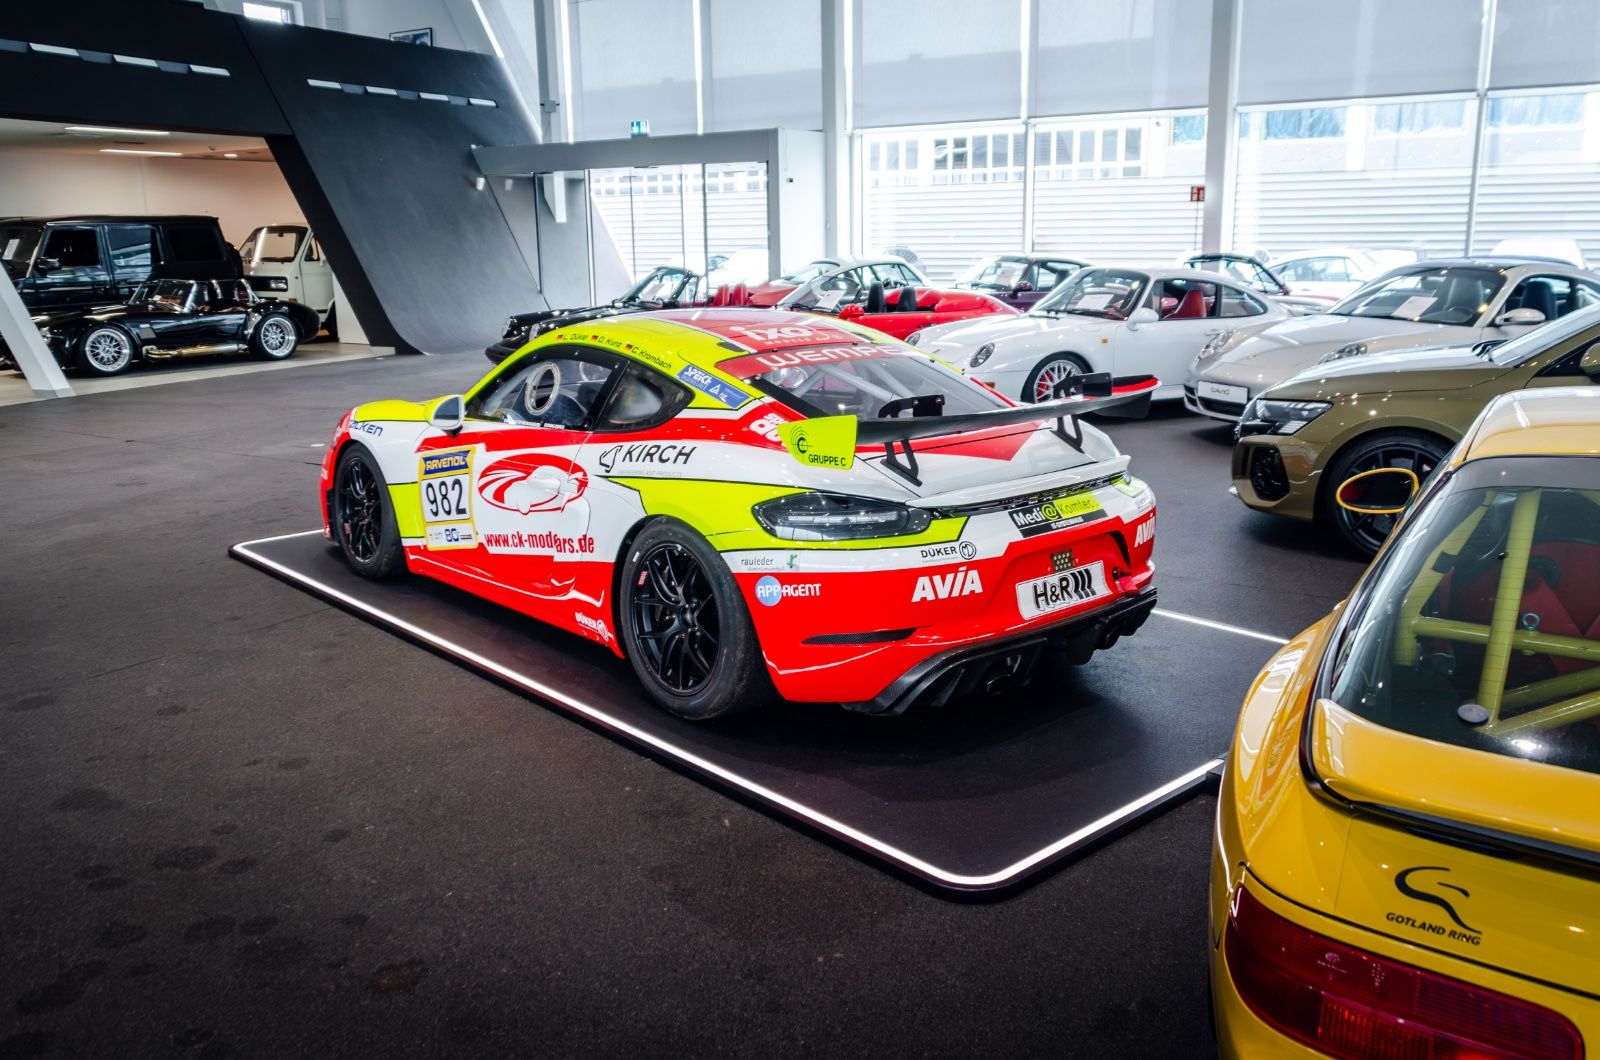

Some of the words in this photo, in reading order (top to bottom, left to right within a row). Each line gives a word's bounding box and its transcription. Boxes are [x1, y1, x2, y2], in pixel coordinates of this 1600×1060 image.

[756, 345, 902, 367] WEMPE
[426, 455, 466, 471] RAVENOL
[622, 444, 698, 465] KIRCH
[808, 454, 839, 466] GRUPPE
[840, 457, 847, 467] C
[425, 478, 467, 517] 982
[741, 556, 773, 566] rauleder
[911, 566, 983, 603] AVIA
[1033, 575, 1074, 610] H&R
[1385, 912, 1446, 936] GOTLAND
[1448, 930, 1481, 946] RING
